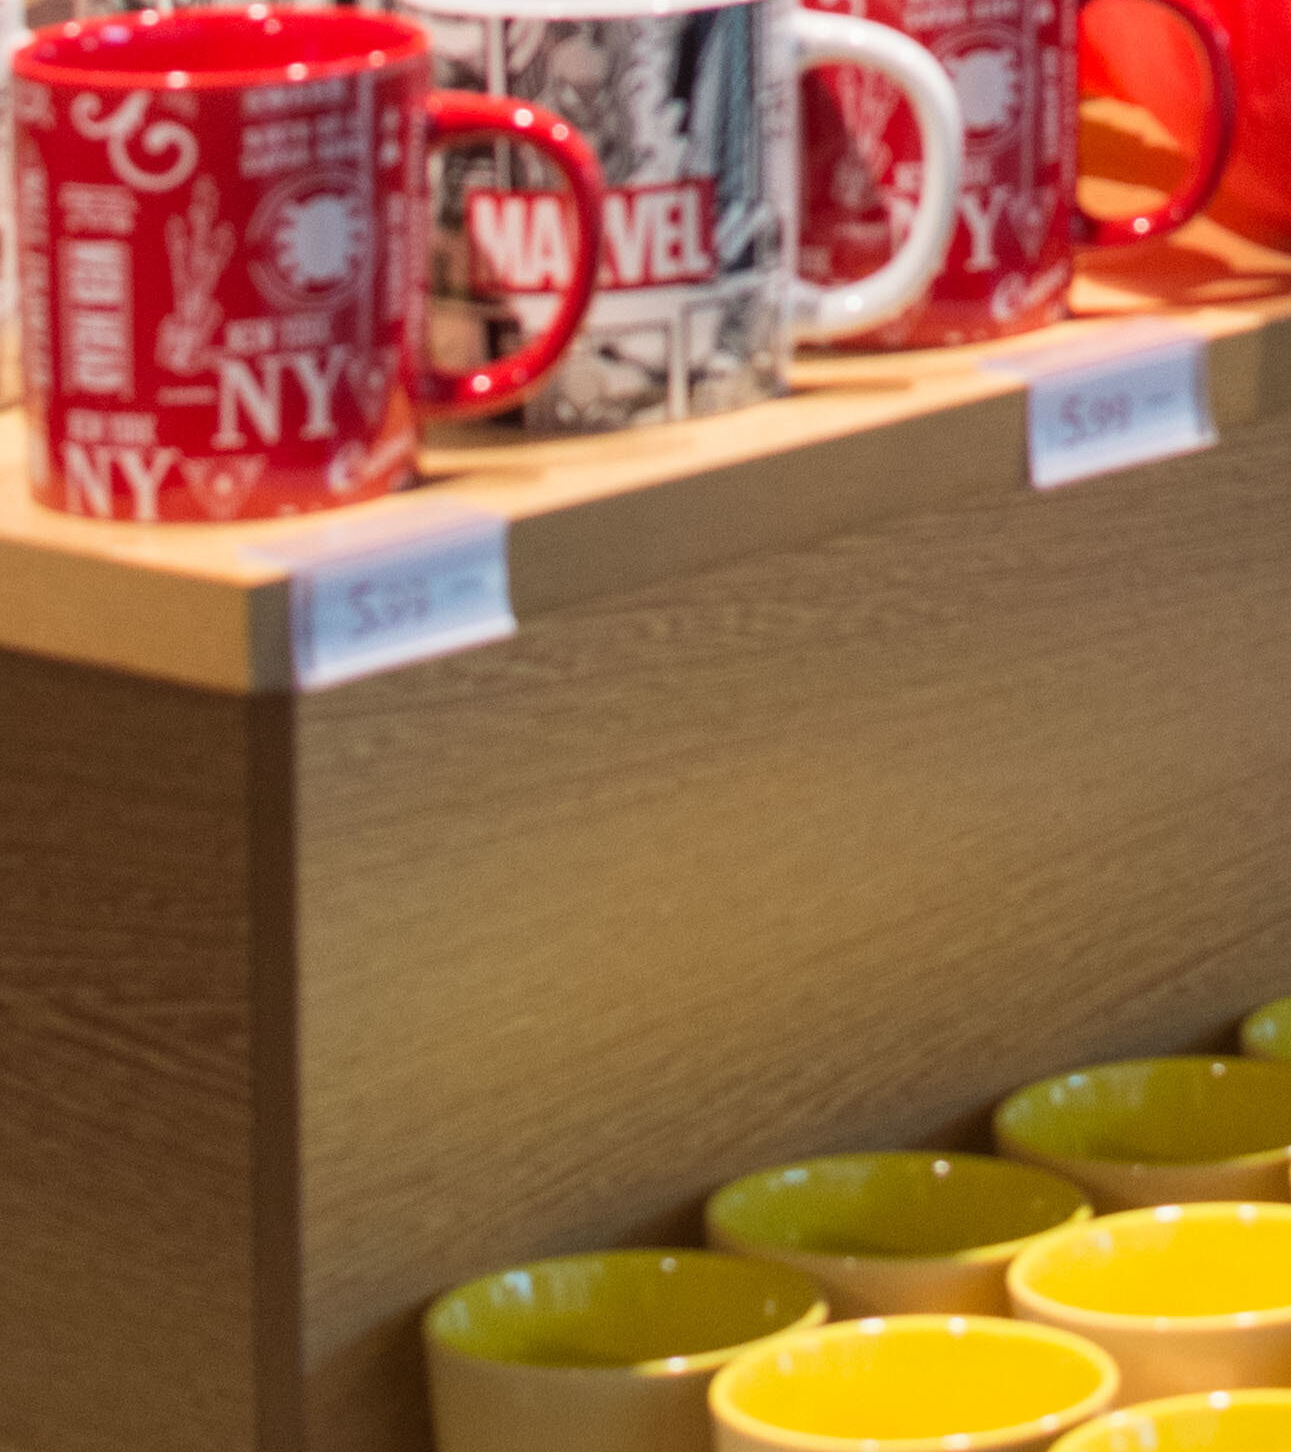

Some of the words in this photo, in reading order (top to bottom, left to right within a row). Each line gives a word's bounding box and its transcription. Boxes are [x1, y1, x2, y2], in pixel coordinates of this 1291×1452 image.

[472, 189, 711, 286] MAVEL
[211, 350, 342, 450] NY
[62, 443, 180, 523] NY
